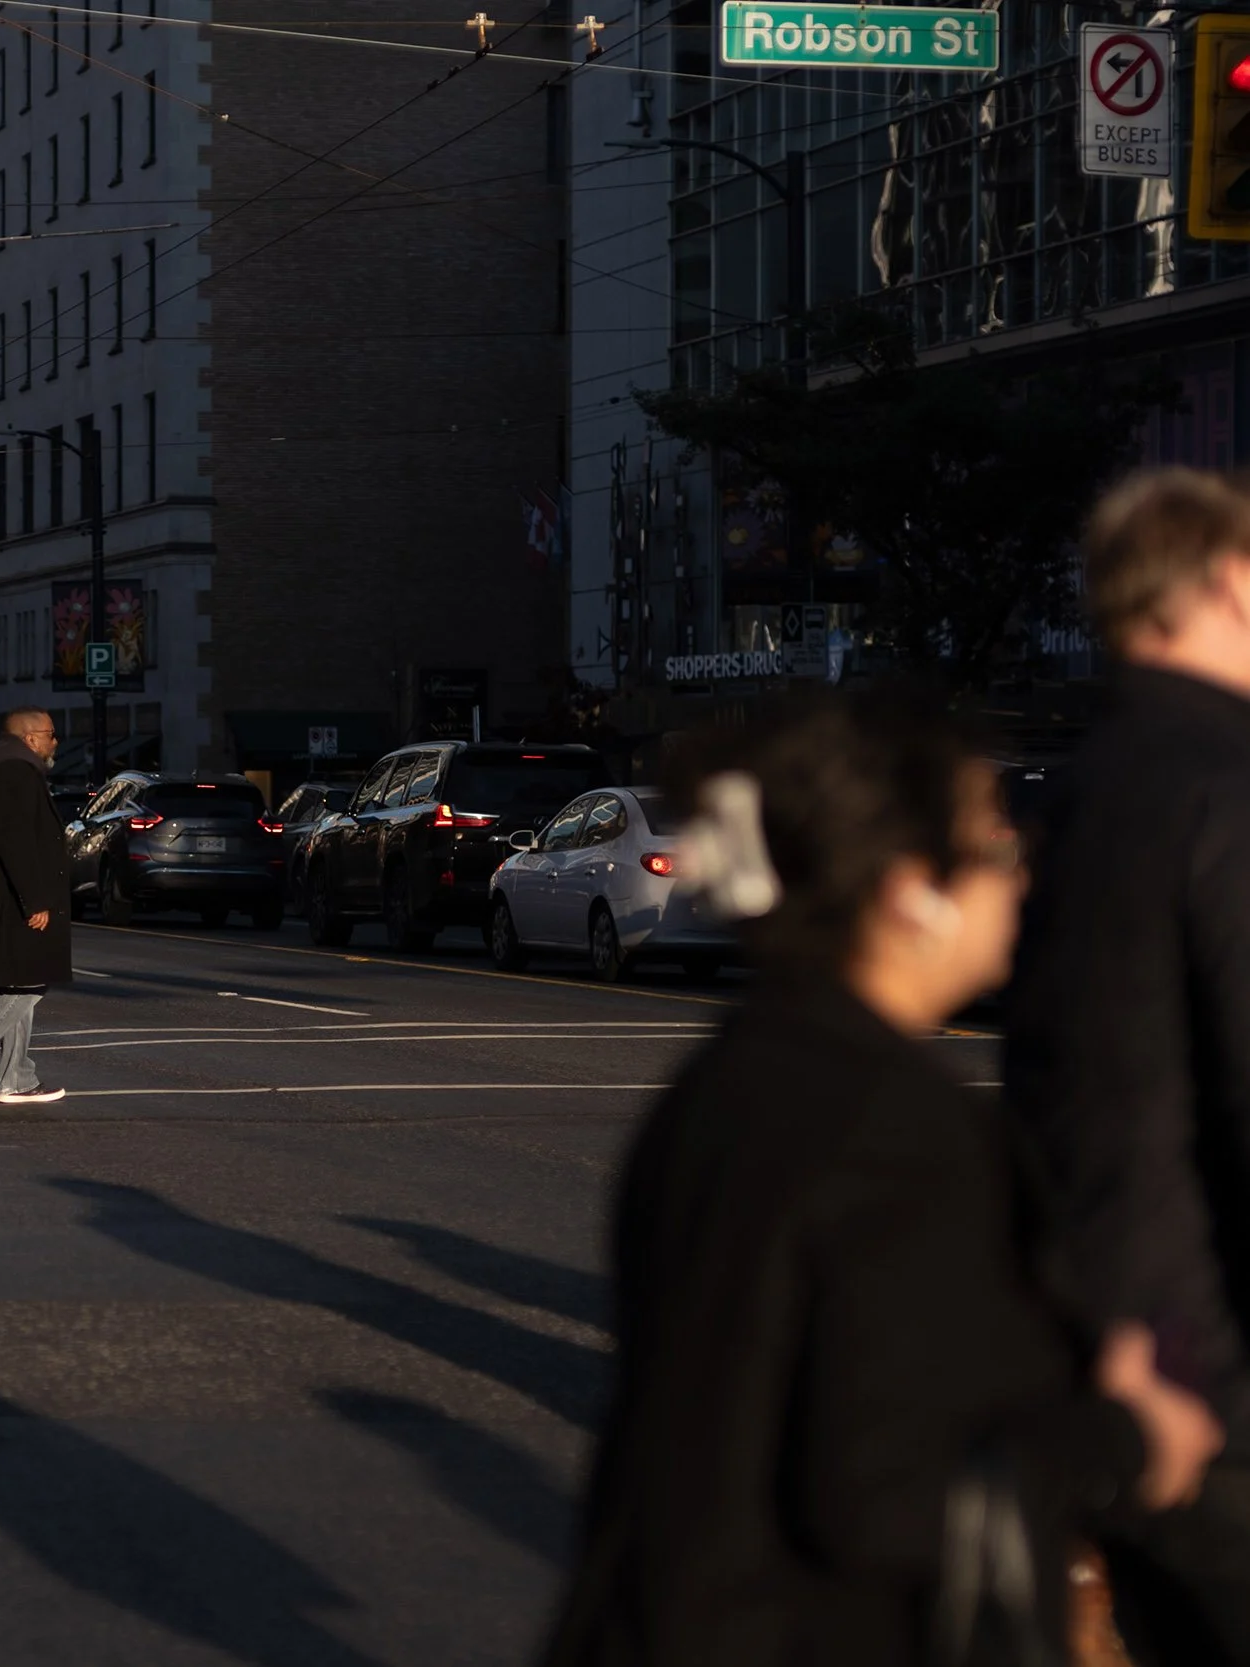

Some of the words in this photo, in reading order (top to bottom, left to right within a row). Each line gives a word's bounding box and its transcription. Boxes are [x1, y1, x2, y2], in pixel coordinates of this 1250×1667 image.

[744, 11, 912, 54] Robson
[933, 17, 979, 57] St
[1094, 124, 1161, 144] EXCEPT
[1098, 145, 1158, 165] BUSES
[91, 648, 110, 670] P
[665, 652, 741, 681] SHOPPERS
[743, 650, 783, 676] DRUG
